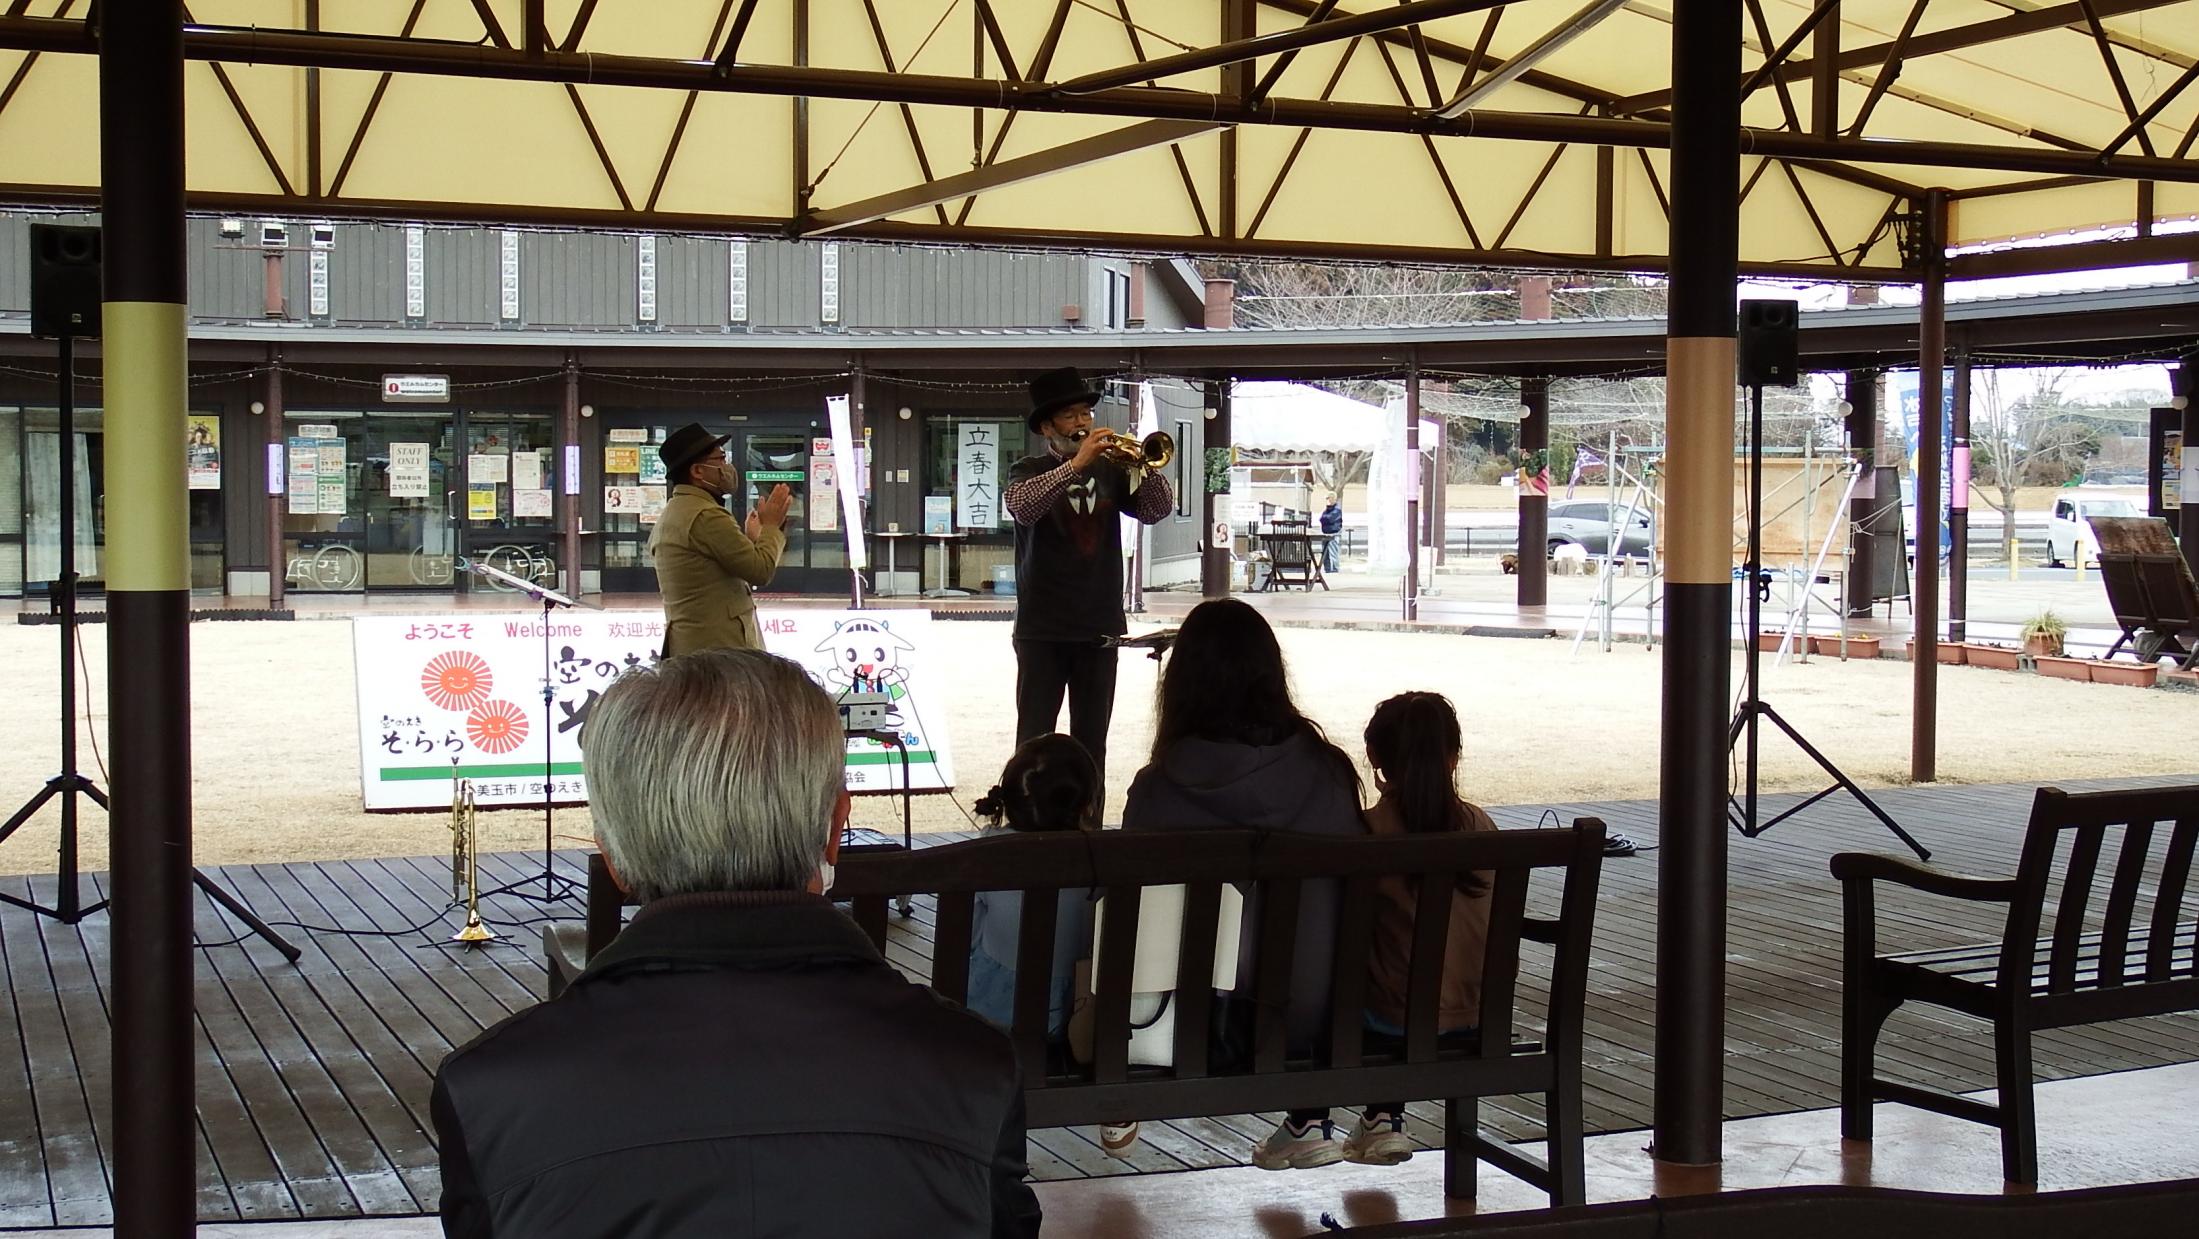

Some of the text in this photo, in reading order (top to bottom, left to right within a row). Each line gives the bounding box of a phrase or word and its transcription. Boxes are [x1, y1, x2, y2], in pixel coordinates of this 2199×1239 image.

[397, 447, 423, 456] STAFF
[397, 457, 422, 465] ONLY
[965, 426, 994, 525] 立春大吉
[404, 622, 475, 641] ようこそ
[504, 621, 583, 638] Welcome
[608, 621, 667, 638] 欢迎光
